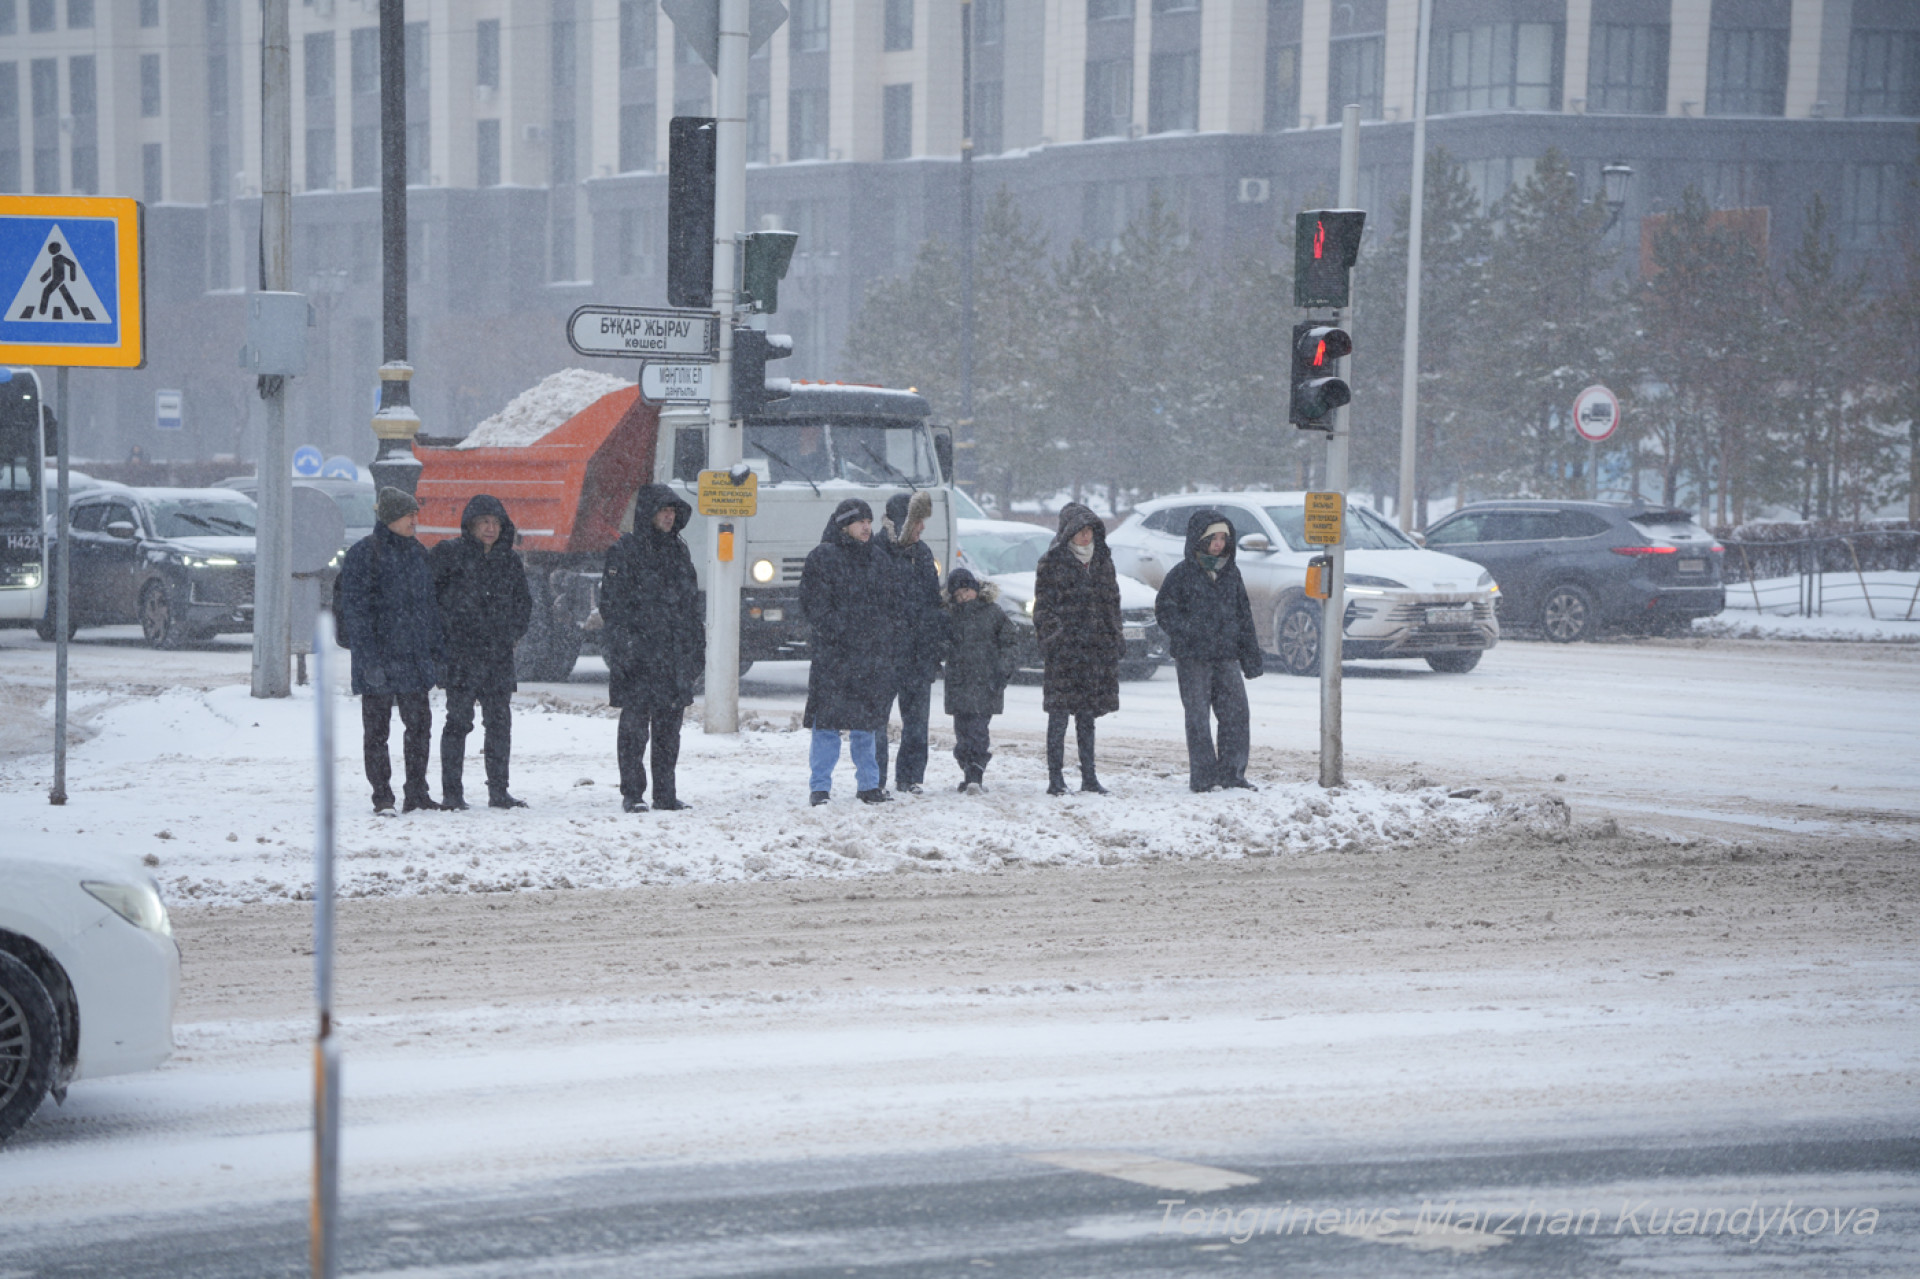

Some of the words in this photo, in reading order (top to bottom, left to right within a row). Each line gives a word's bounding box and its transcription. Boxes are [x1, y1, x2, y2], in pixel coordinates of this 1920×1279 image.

[600, 317, 641, 338] БҰҚАР
[644, 319, 691, 338] ЖЫРАУ
[625, 338, 667, 350] көшесі
